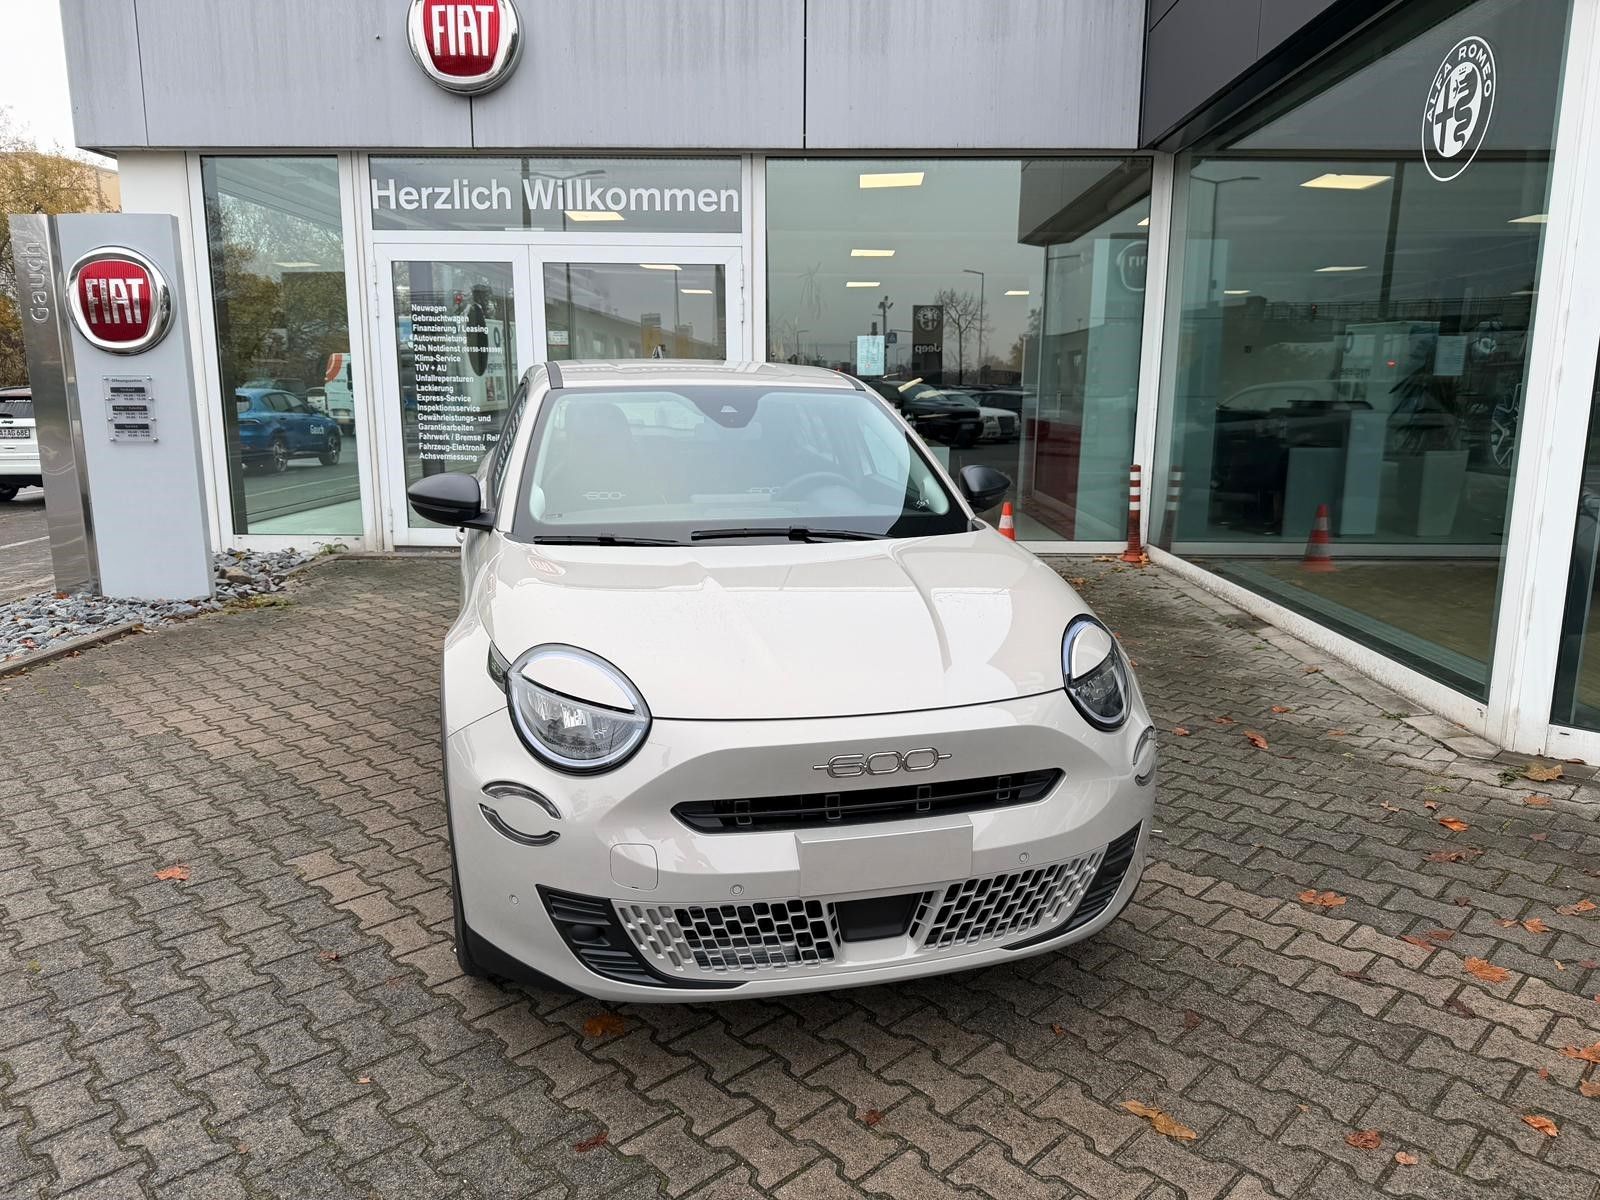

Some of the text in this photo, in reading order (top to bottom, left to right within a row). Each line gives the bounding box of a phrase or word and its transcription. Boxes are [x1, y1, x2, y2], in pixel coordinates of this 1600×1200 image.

[431, 4, 494, 57] FIAT
[1427, 44, 1492, 122] ALFA ROMEO
[371, 178, 739, 212] Herzlich Willkommen
[84, 278, 144, 324] FIAT
[411, 304, 447, 313] Neuwagen
[412, 314, 469, 323] Gebrauchtwagen
[412, 324, 457, 334] Finanzierung
[462, 325, 489, 334] Leasing
[413, 334, 467, 344] Autovermietung
[414, 354, 460, 362] Klima-Service
[415, 362, 429, 372] TÜV
[437, 364, 447, 372] AU
[416, 384, 454, 393] Lackierung
[416, 393, 472, 403] Express-Service
[417, 403, 481, 412] Inspektionsservice
[418, 413, 491, 423] Gewährleistungs- und
[418, 423, 474, 431] Garantiearbeiten
[419, 432, 449, 441] Fahrwerk
[455, 433, 481, 441] Bremse
[419, 442, 486, 451] Fahrzeug-Elektronik
[419, 452, 477, 461] Achsvermessung
[825, 747, 941, 778] 600
